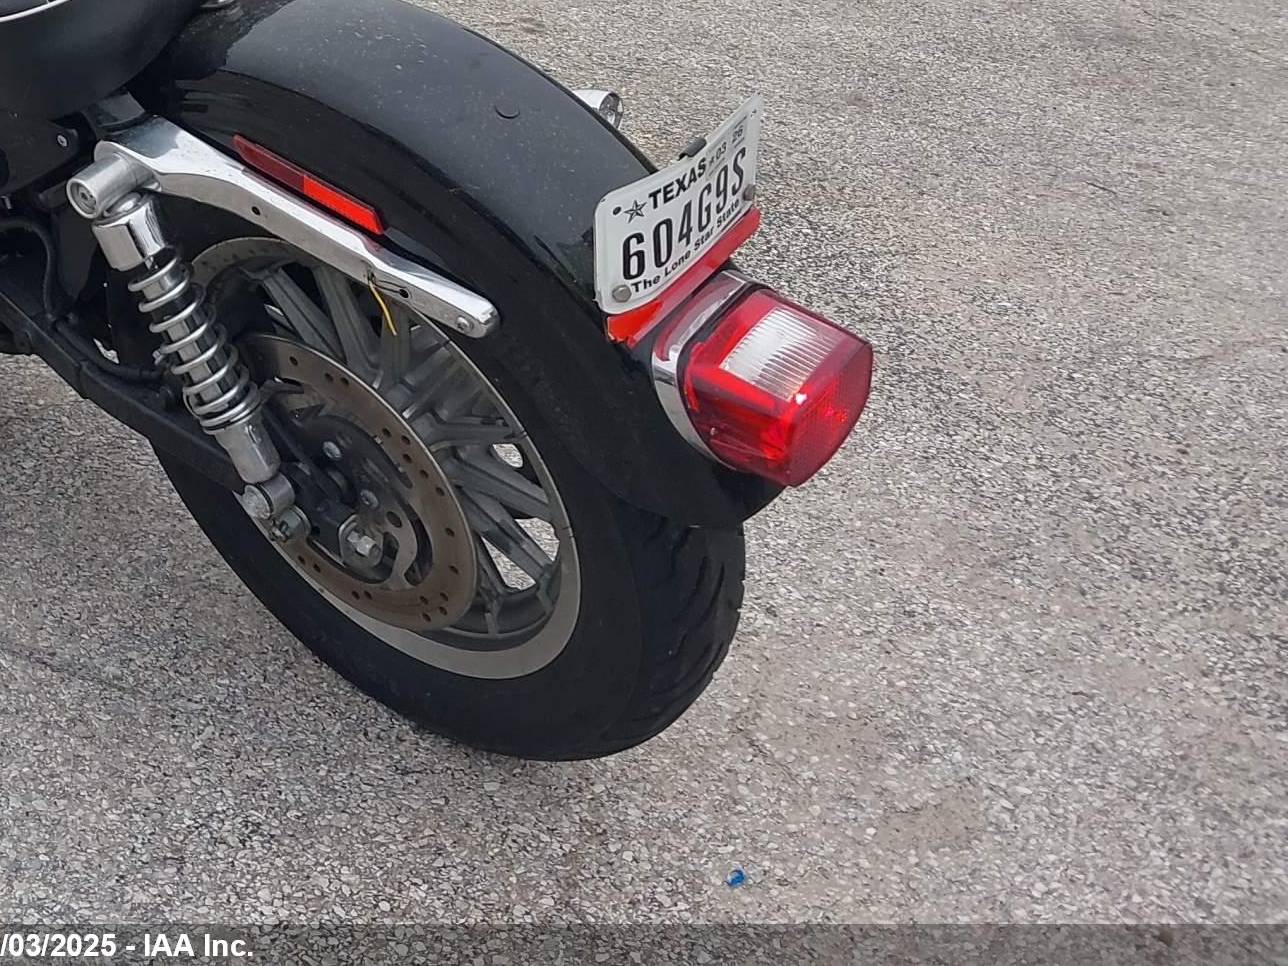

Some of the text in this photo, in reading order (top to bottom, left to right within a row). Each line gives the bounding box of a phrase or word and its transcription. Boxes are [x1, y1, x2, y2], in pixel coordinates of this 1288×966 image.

[648, 156, 707, 210] TEXAS
[715, 141, 728, 160] 03
[622, 146, 747, 281] 604G9S
[630, 198, 741, 294] The Lone Star State
